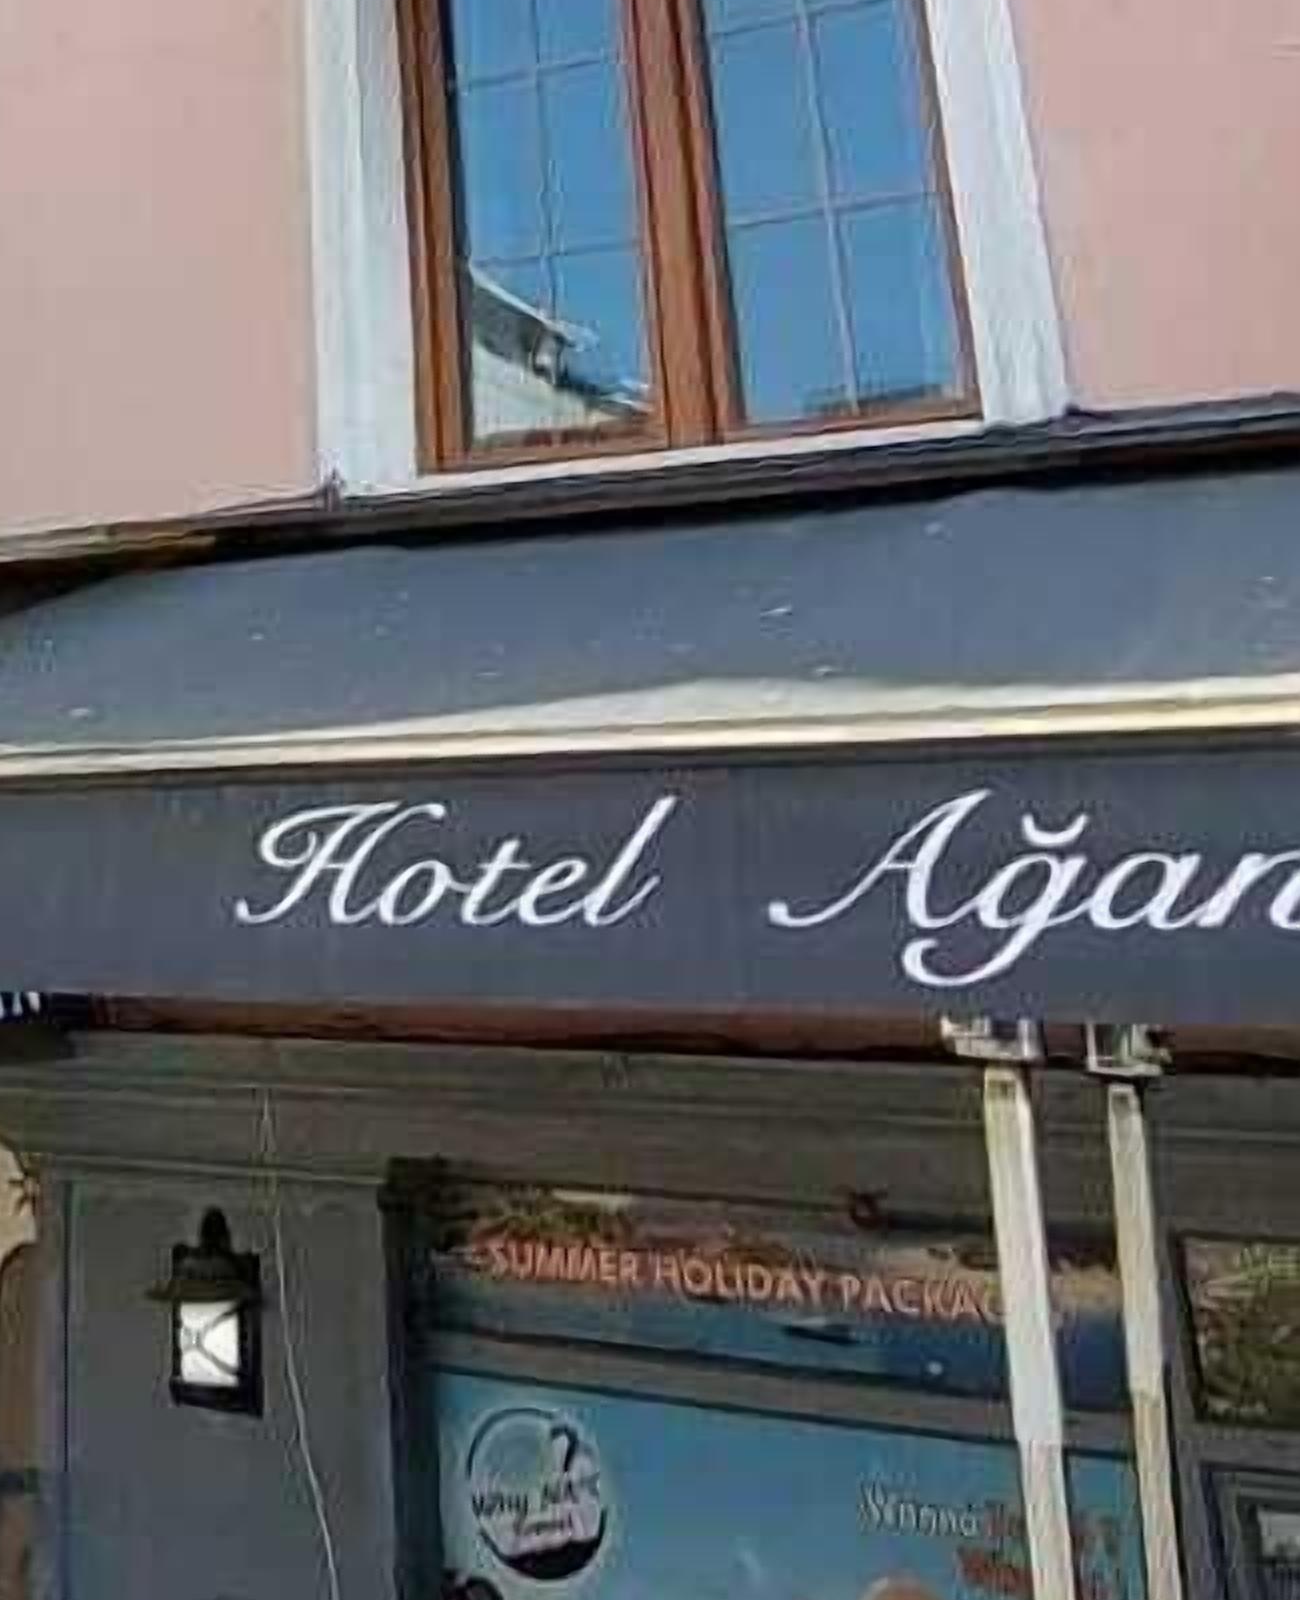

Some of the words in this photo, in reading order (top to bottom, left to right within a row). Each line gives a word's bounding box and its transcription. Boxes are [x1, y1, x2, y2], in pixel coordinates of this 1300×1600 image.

[234, 794, 678, 928] Hotel
[765, 787, 1300, 987] Ağan
[488, 1240, 640, 1282] SUMMER
[651, 1250, 825, 1303] HOLIDAY
